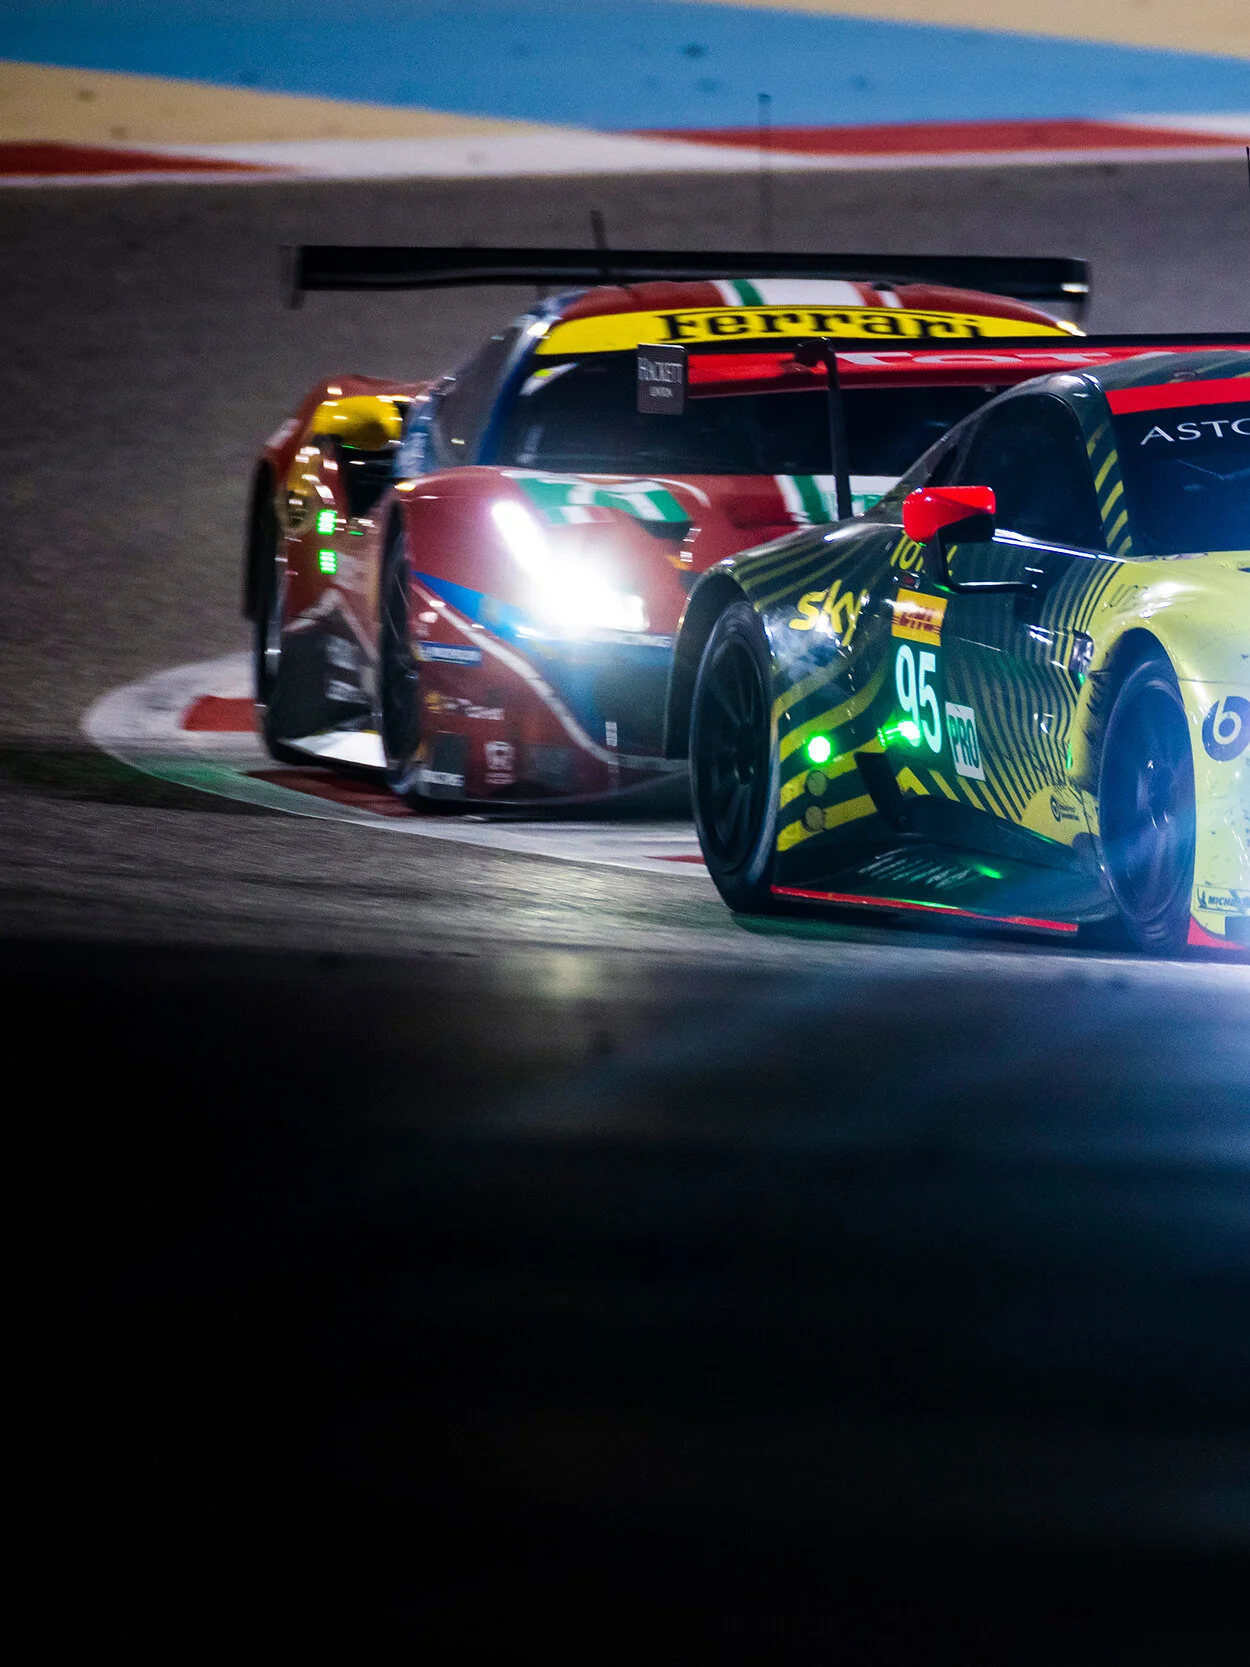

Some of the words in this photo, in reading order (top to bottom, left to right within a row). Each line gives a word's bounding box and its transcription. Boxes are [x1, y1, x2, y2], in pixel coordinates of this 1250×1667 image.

[655, 304, 983, 341] Ferrari
[789, 579, 868, 647] sky
[895, 644, 942, 753] 95
[947, 714, 980, 769] PRO
